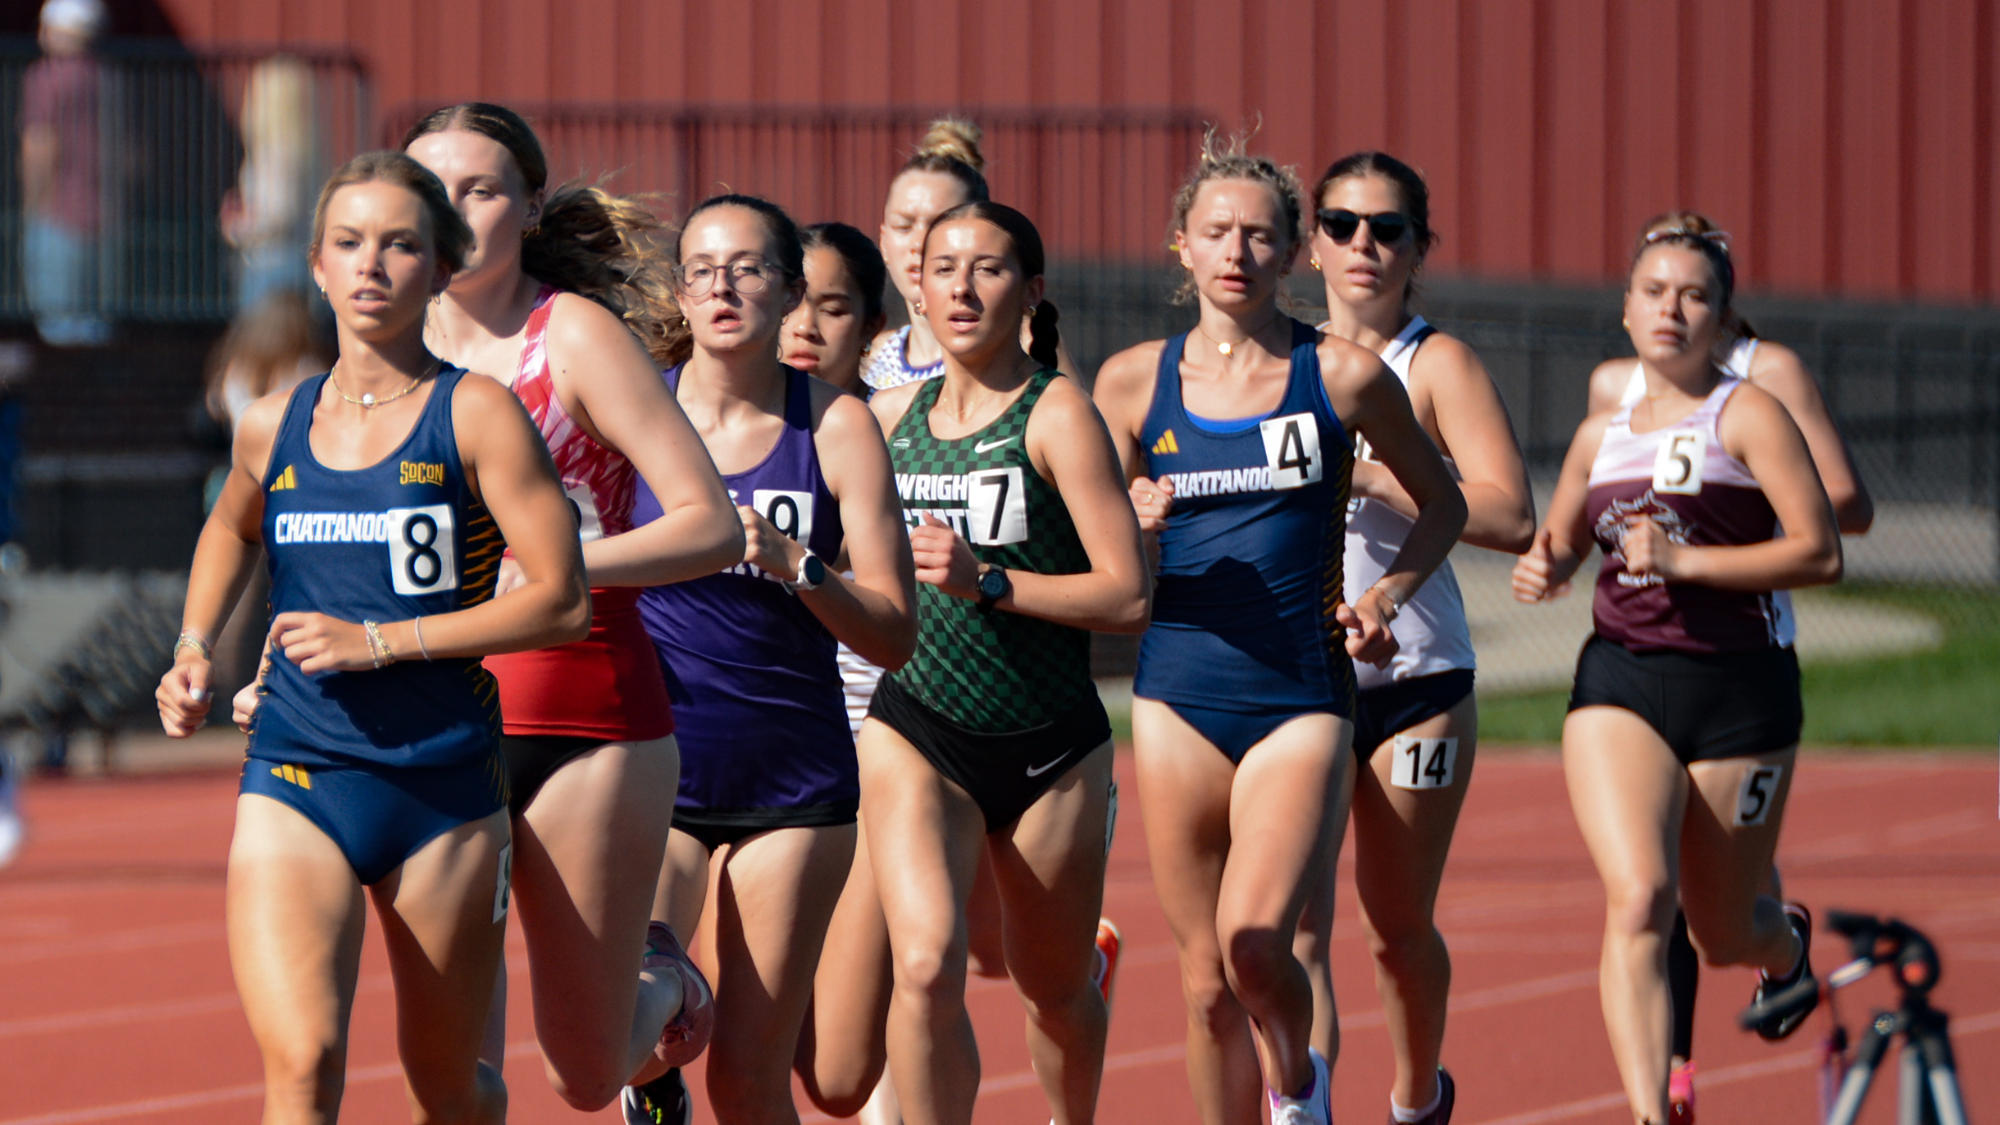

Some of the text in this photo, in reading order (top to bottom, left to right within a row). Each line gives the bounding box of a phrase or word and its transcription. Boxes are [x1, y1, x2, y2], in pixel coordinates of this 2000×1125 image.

[1277, 420, 1312, 480] 4
[1665, 436, 1695, 487] 5
[980, 474, 1009, 541] 7
[1167, 465, 1273, 498] HATTANOO
[403, 513, 443, 588] 8
[1405, 741, 1447, 785] 14
[1741, 769, 1774, 822] 5
